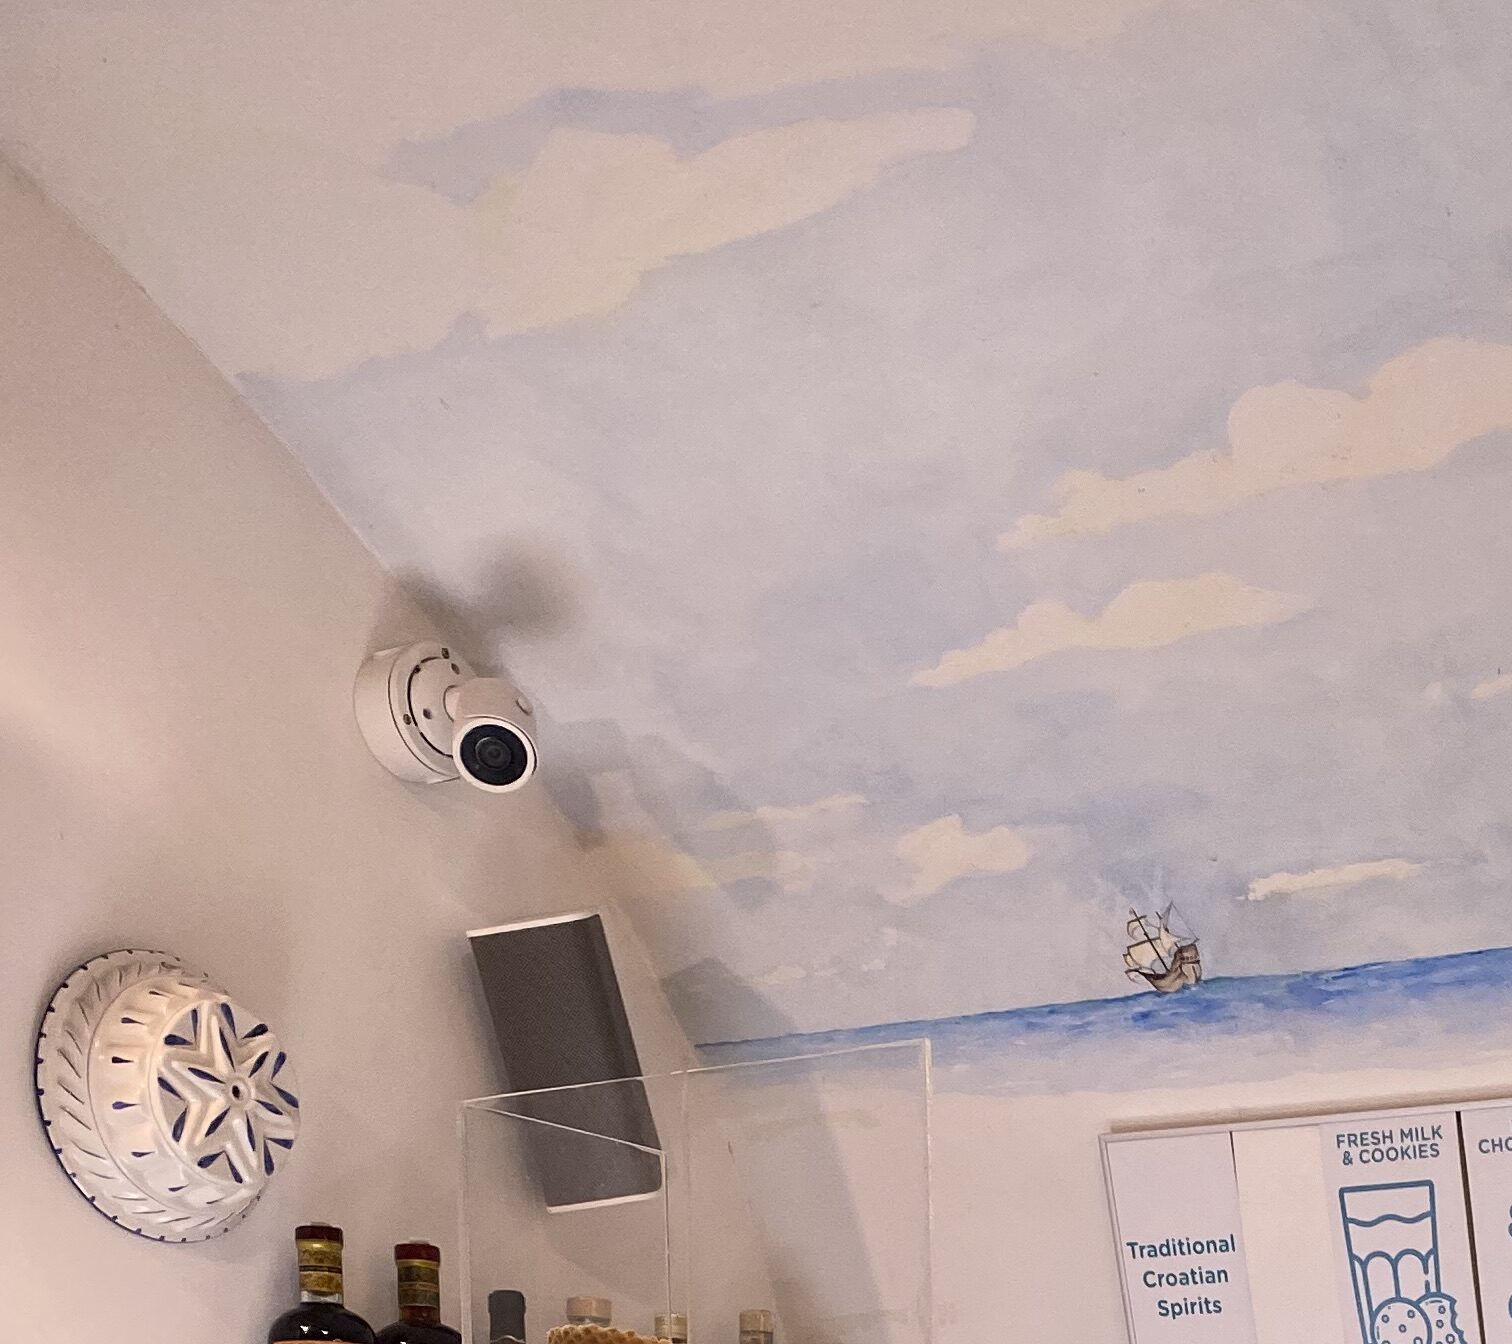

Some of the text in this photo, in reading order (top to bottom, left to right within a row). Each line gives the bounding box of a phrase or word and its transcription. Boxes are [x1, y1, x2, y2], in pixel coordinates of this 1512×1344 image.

[1336, 1125, 1443, 1149] FRESH MILK
[1342, 1143, 1440, 1165] & COOKIES
[1127, 1234, 1236, 1259] Traditional
[1143, 1266, 1229, 1289] Croatian
[1157, 1296, 1222, 1319] Spirits
